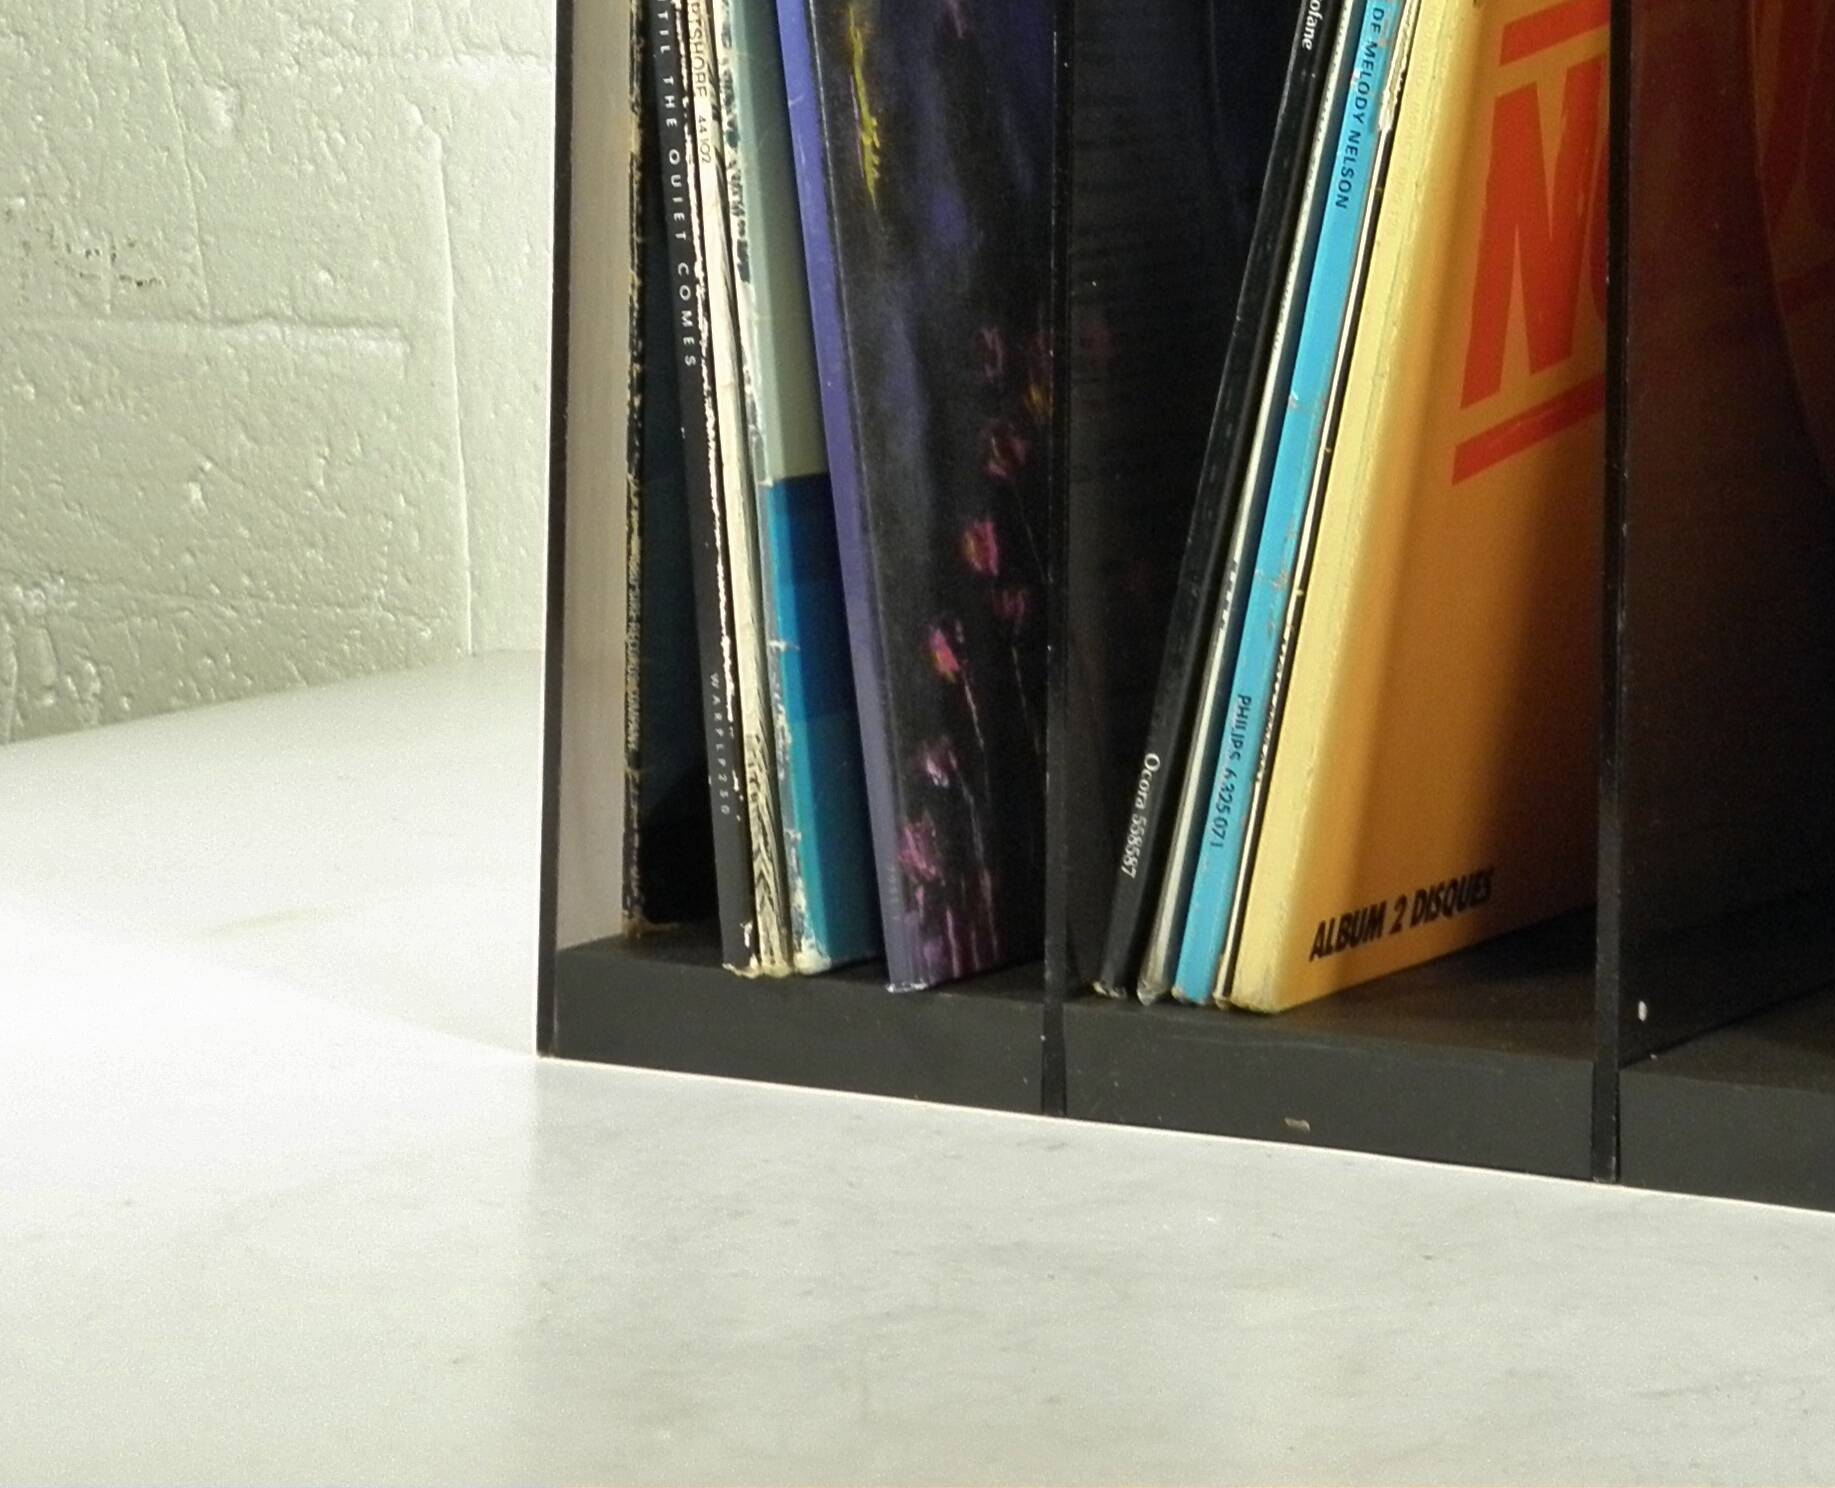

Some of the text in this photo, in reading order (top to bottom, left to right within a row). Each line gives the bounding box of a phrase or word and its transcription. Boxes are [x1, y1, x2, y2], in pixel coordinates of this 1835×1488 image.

[1371, 7, 1385, 35] DE
[1352, 40, 1378, 125] MELODY
[1335, 129, 1361, 210] NELSON
[663, 76, 678, 127] THE
[677, 262, 697, 367] COMES
[1137, 752, 1161, 810] Ocora
[1309, 866, 1495, 962] ALBUM 2 DISQUES
